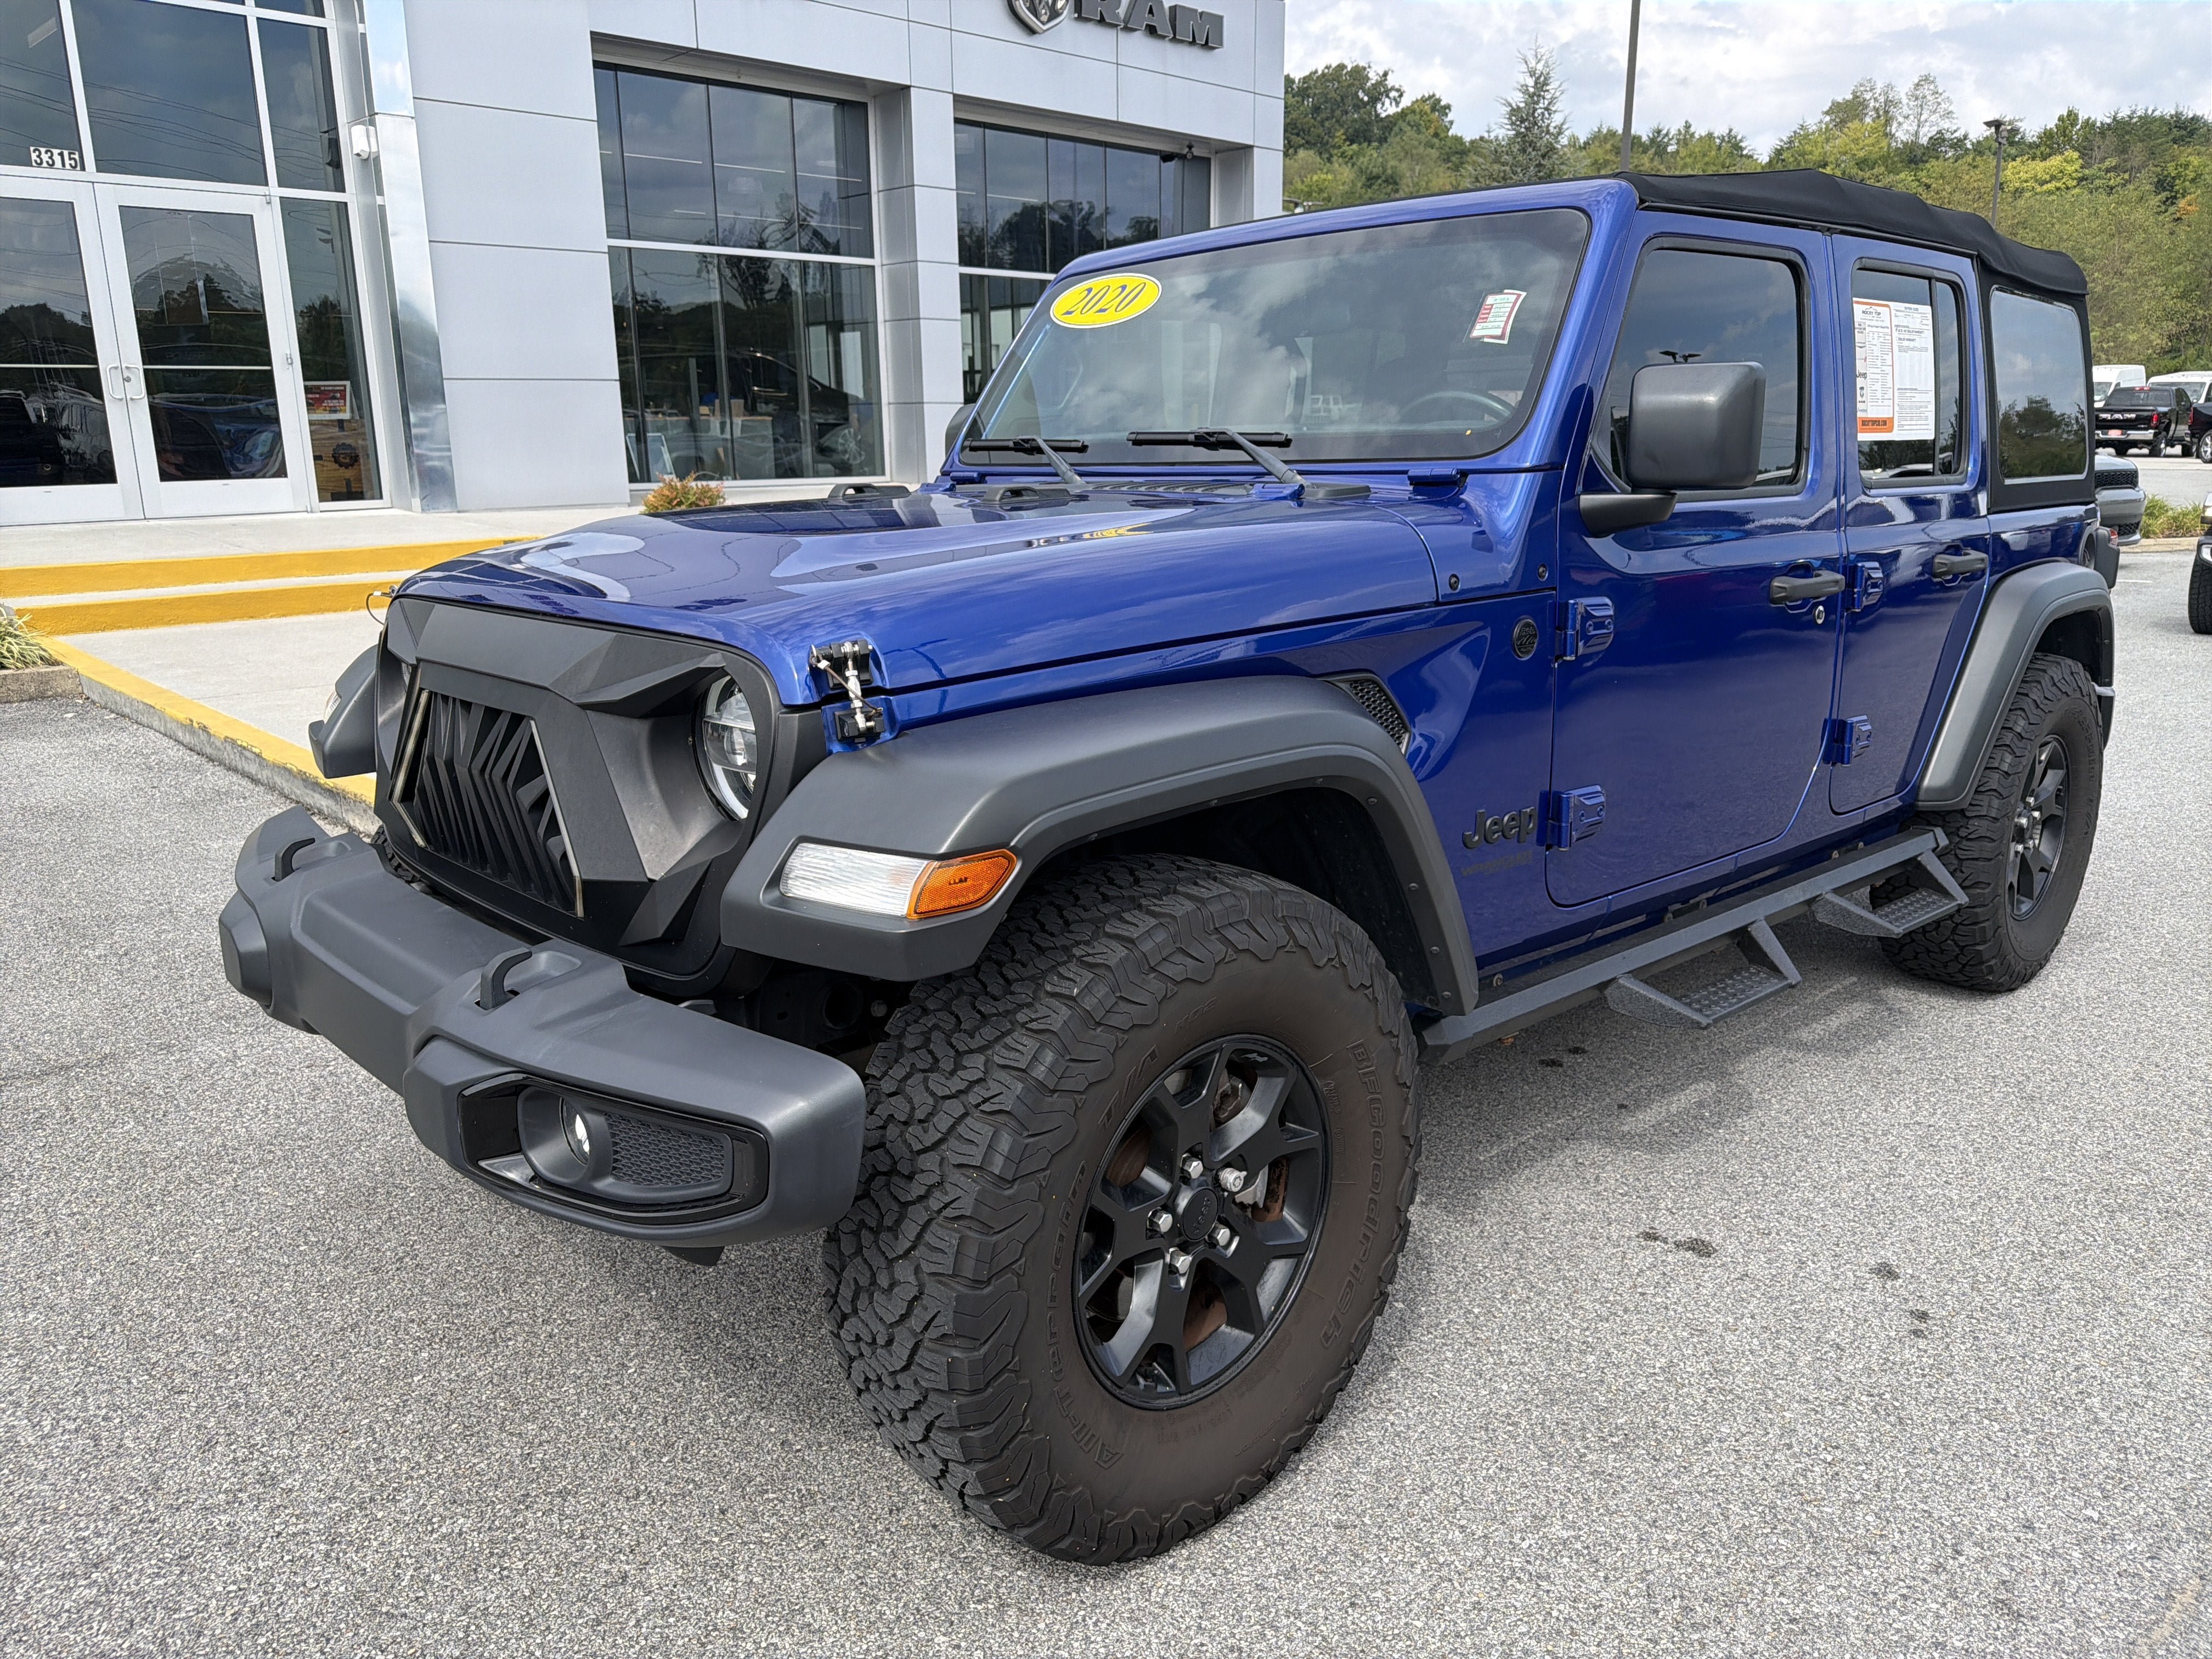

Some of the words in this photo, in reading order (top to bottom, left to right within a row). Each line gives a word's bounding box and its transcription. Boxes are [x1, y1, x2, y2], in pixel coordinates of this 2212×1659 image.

[1078, 0, 1224, 48] RAM
[33, 148, 77, 168] 3315
[1060, 282, 1147, 316] 2020
[1462, 806, 1537, 849] Jeep
[1320, 1038, 1387, 1349] BFGoodrich
[1192, 1196, 1212, 1234] Jeep
